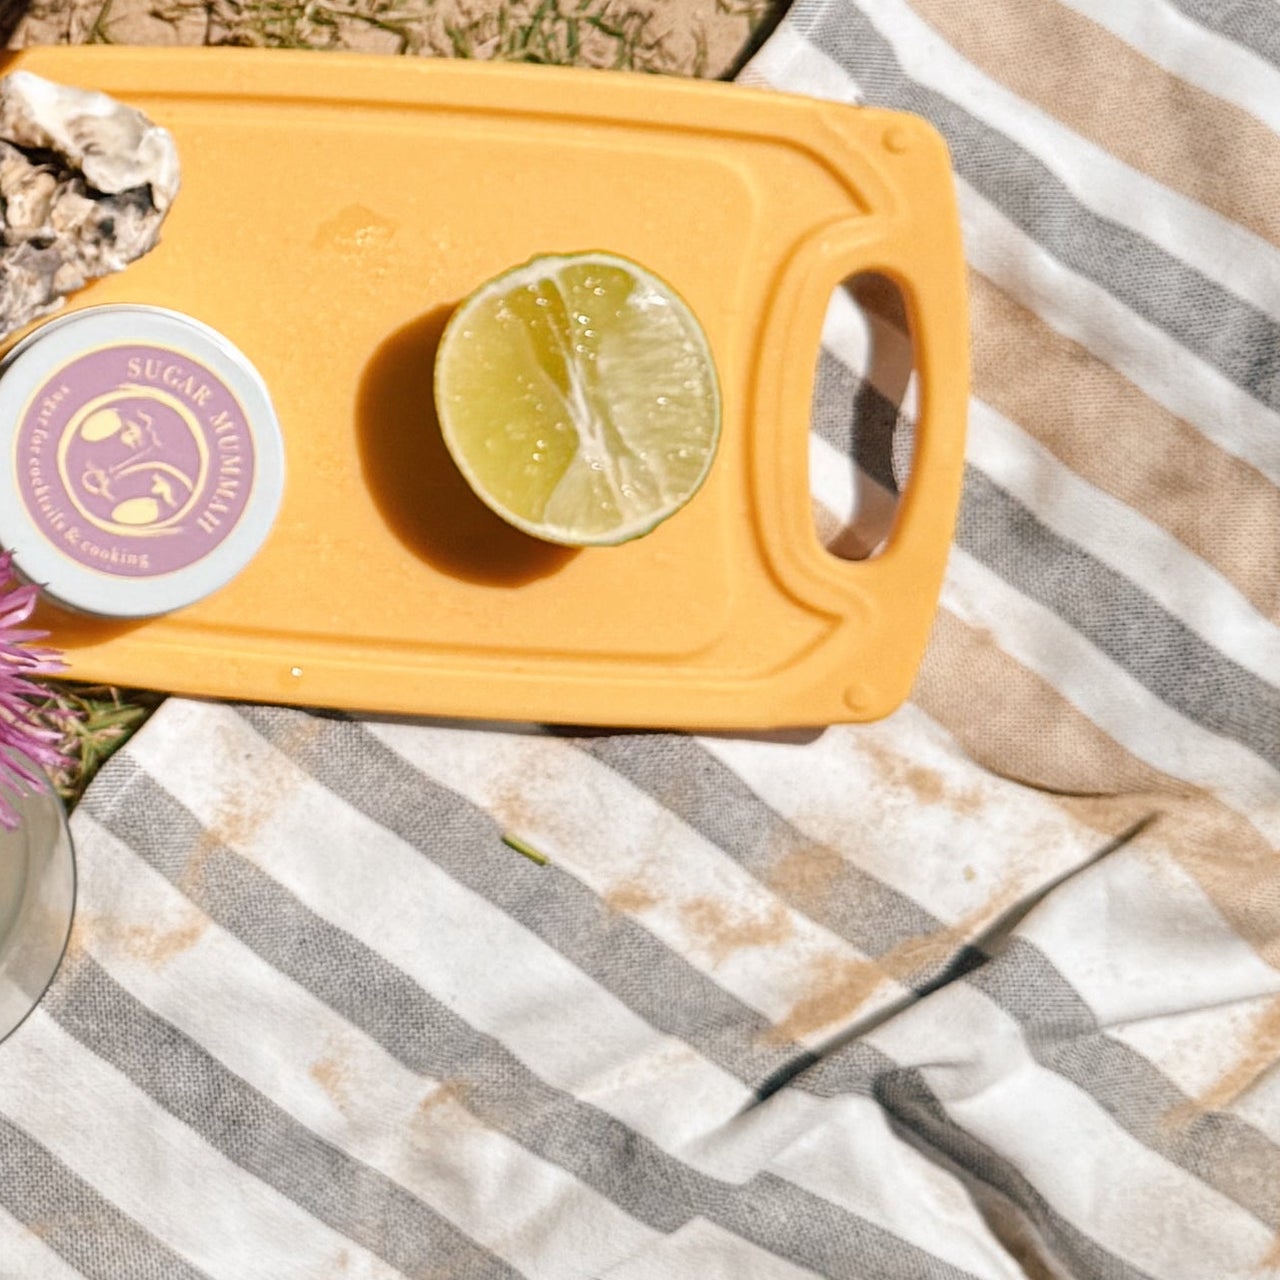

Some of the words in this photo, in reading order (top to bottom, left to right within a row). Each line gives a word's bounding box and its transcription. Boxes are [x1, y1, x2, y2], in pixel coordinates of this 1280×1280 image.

[127, 357, 213, 407] SUGAR
[195, 410, 241, 534] MUMMAH
[80, 540, 150, 569] cooking
